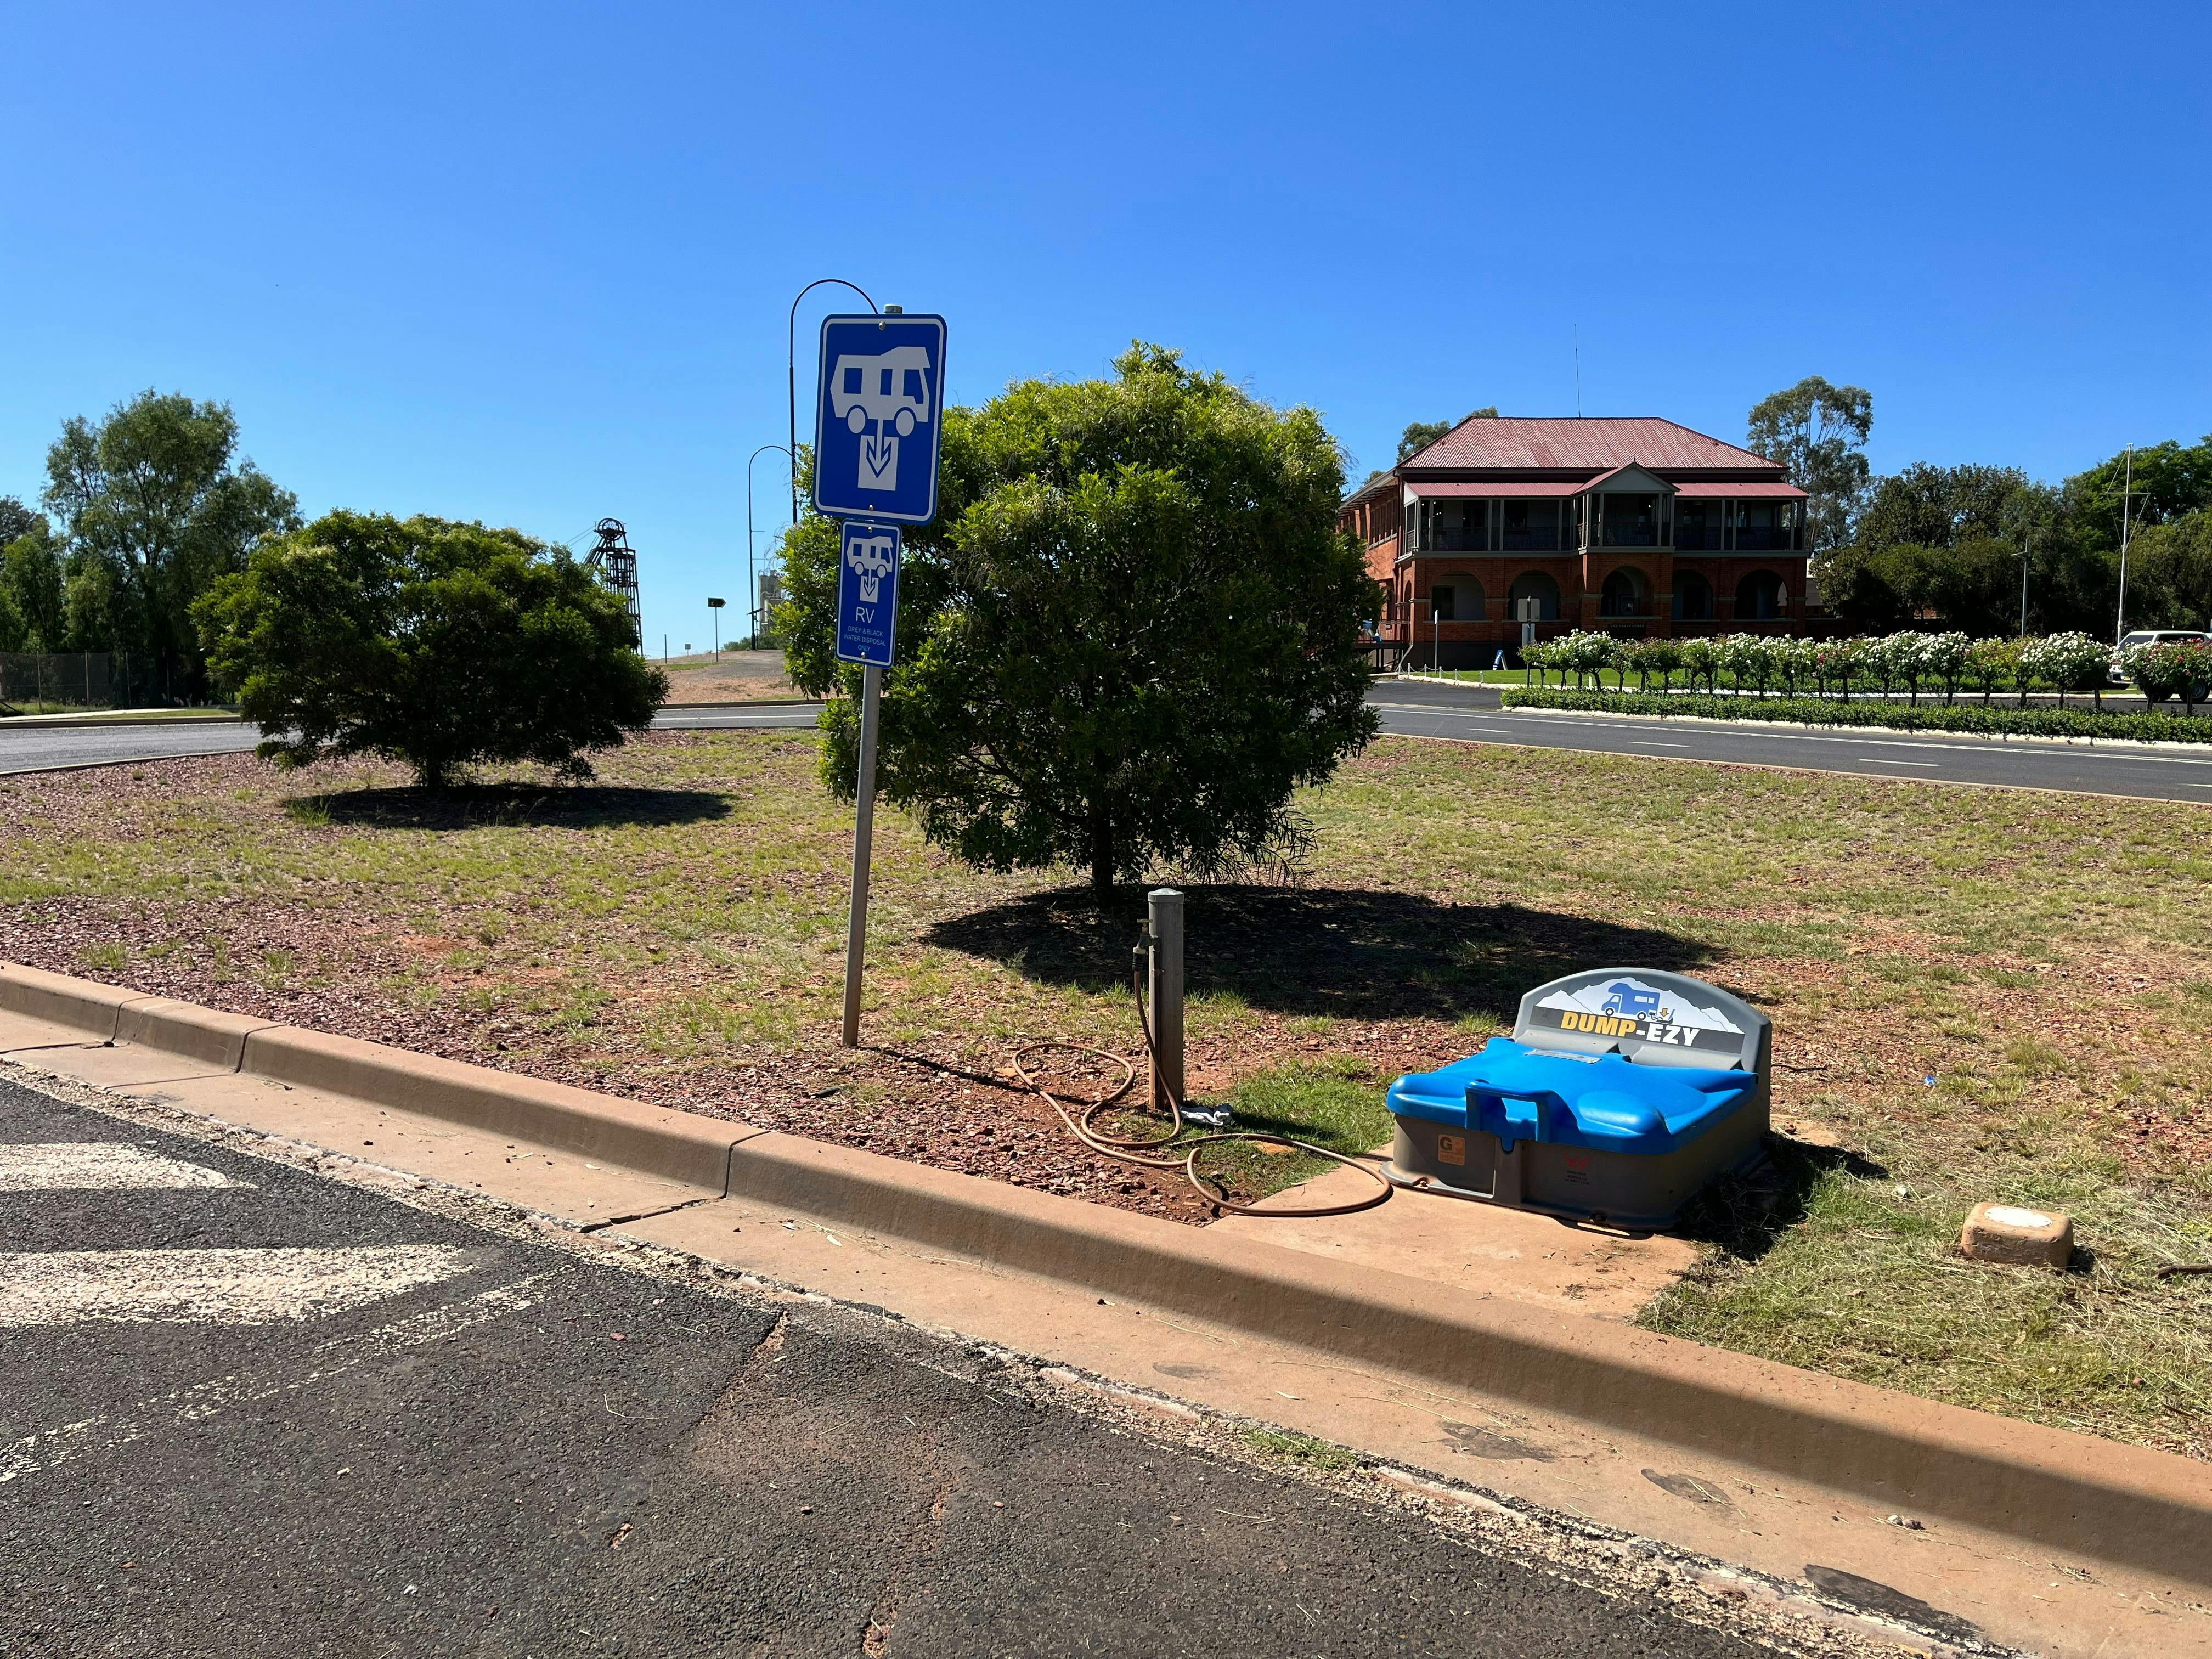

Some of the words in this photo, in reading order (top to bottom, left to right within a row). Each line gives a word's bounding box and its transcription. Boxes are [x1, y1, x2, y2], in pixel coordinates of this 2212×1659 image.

[856, 606, 875, 623] RV
[867, 629, 883, 637] BLACK
[861, 636, 886, 646] DISPOSAL
[1560, 1011, 1700, 1046] DUMP-EZY
